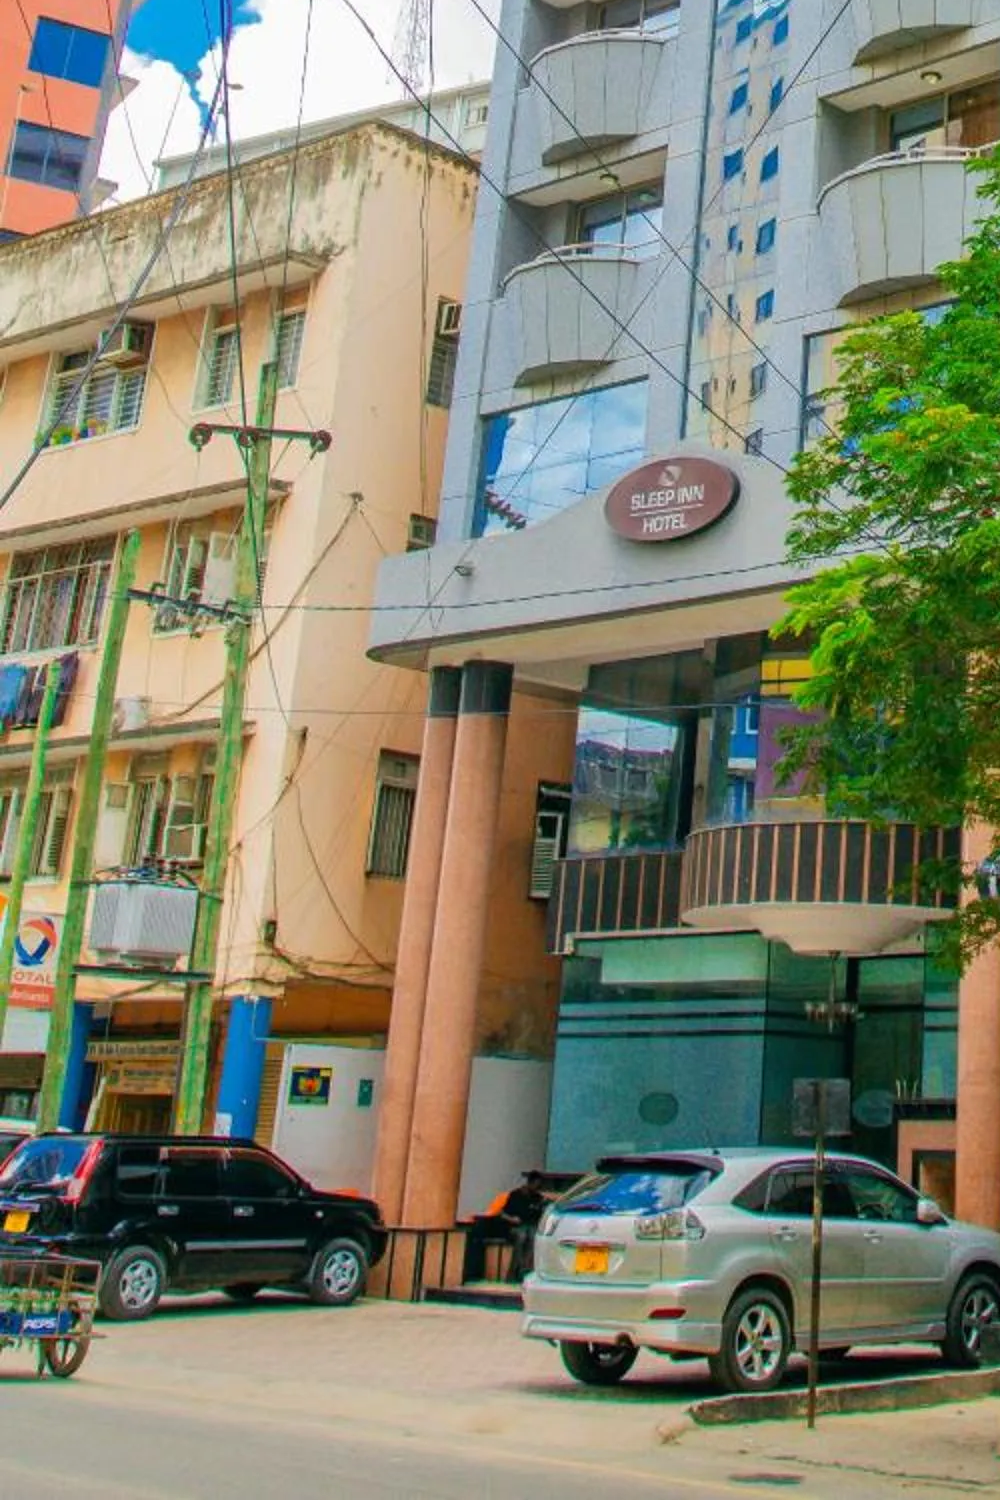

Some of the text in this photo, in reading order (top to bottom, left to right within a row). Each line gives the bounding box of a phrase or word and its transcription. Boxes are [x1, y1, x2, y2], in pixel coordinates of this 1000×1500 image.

[631, 483, 705, 511] SLEEP INN
[642, 512, 688, 533] HOTEL
